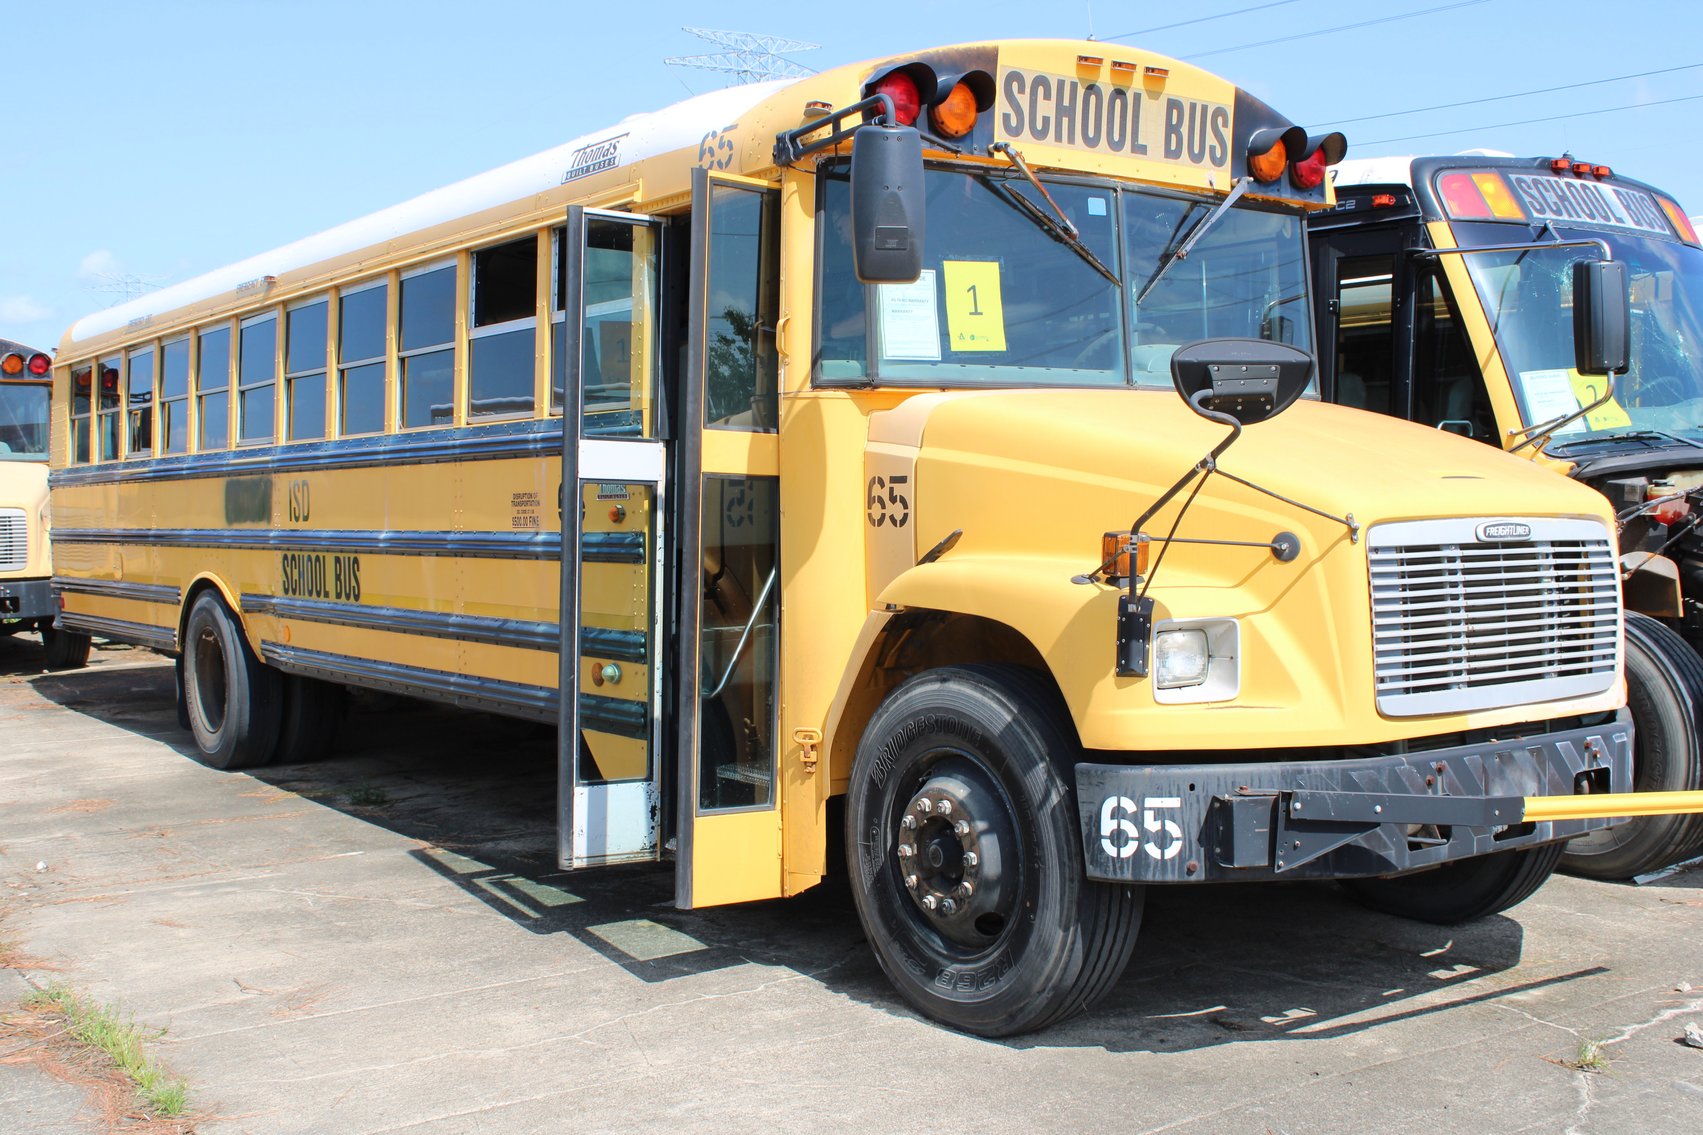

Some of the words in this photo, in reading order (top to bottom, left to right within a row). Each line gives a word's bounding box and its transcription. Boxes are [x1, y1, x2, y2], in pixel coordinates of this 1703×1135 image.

[1001, 70, 1148, 156] SCHOOL
[1163, 97, 1229, 168] BUS
[571, 132, 630, 169] Thomas
[698, 123, 739, 169] 65
[566, 167, 587, 180] BUILT
[589, 157, 615, 172] BUSES
[1335, 199, 1356, 210] C2
[1514, 177, 1626, 224] SCHOOL
[1612, 188, 1667, 232] BUS
[966, 284, 983, 316] 1
[289, 479, 310, 523] ISD
[512, 492, 533, 500] DISRUPTION
[867, 475, 909, 528] 65
[528, 516, 540, 526] FINE
[1485, 525, 1530, 537] FREIGHTLINER
[282, 553, 329, 599] SCHOOL
[334, 555, 361, 602] BUS
[871, 713, 984, 789] BRIDGESTONE
[1100, 796, 1183, 860] 65
